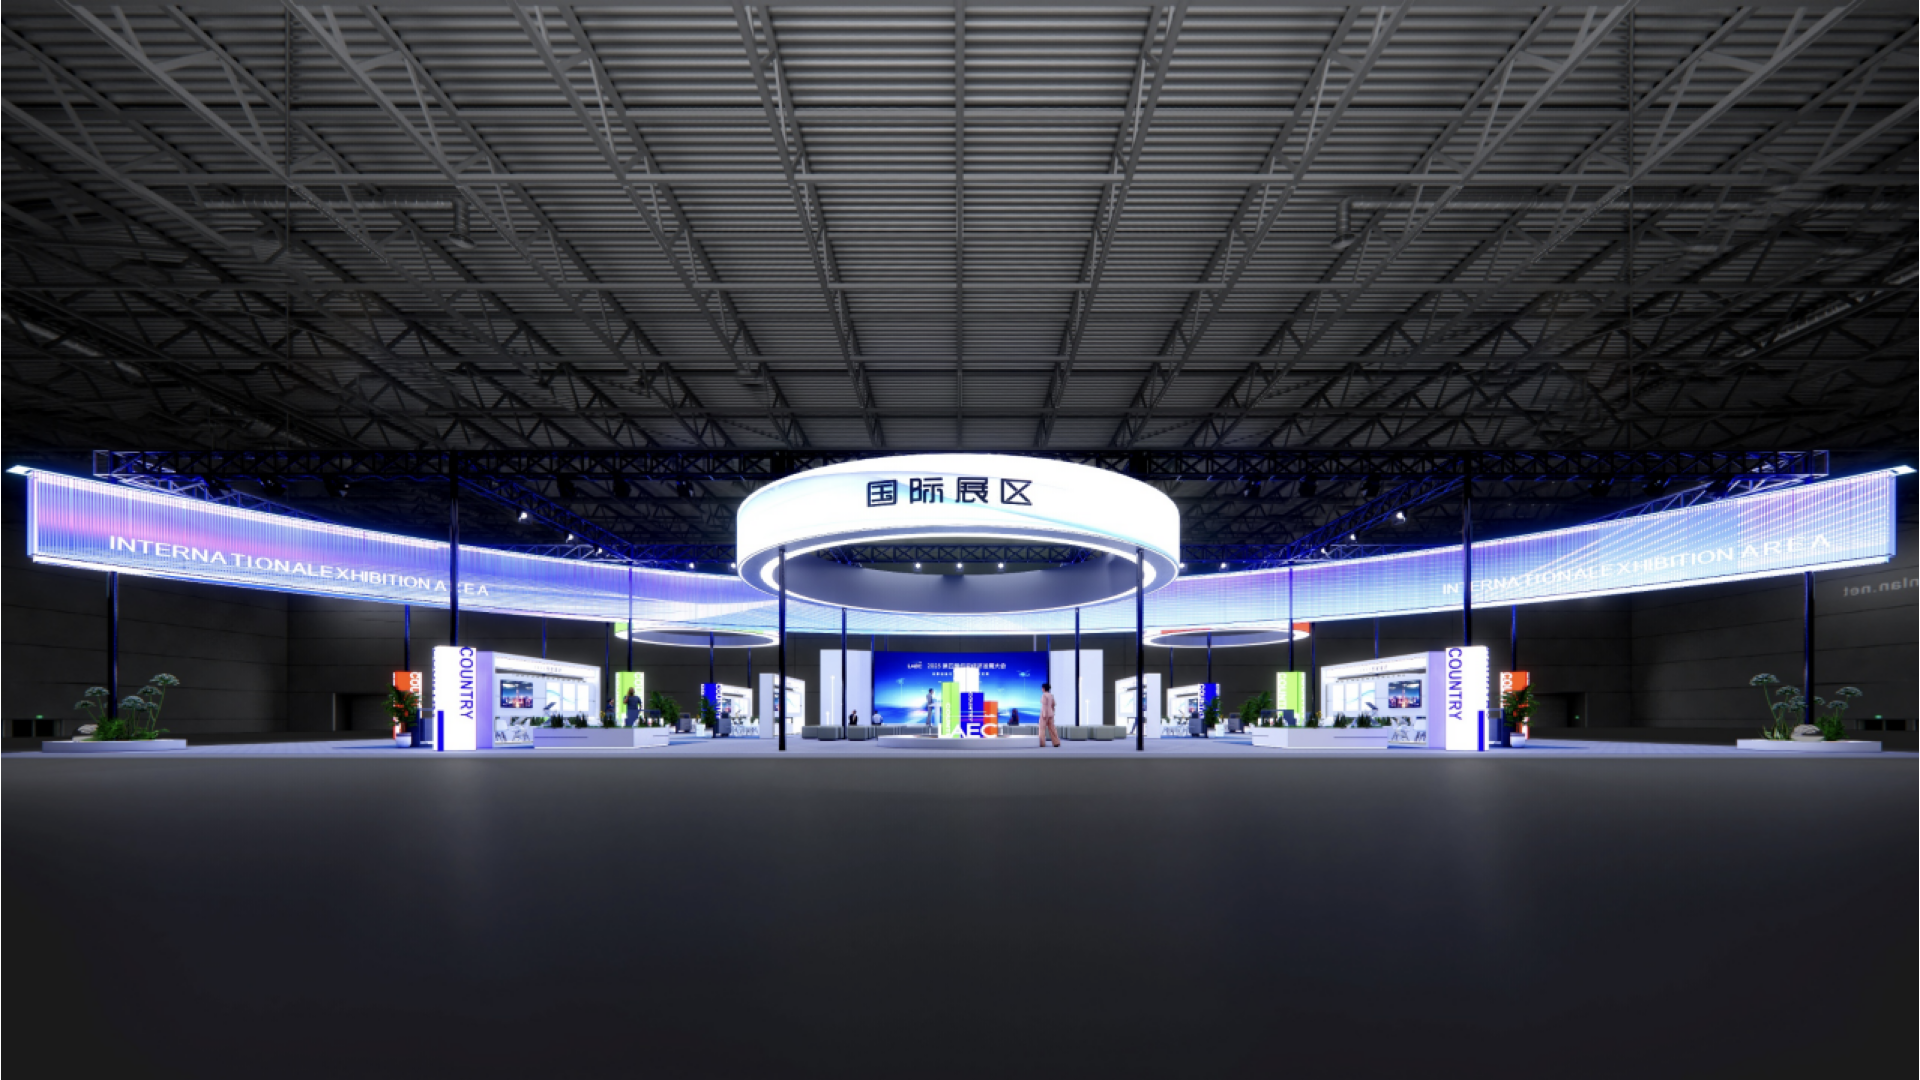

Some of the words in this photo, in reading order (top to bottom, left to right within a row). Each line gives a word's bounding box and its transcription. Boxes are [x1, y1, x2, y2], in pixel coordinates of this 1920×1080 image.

[867, 476, 1033, 508] 国际展区
[459, 646, 474, 720] COUNTRY
[1448, 647, 1463, 721] COUNTRY
[938, 722, 999, 739] LAEC
